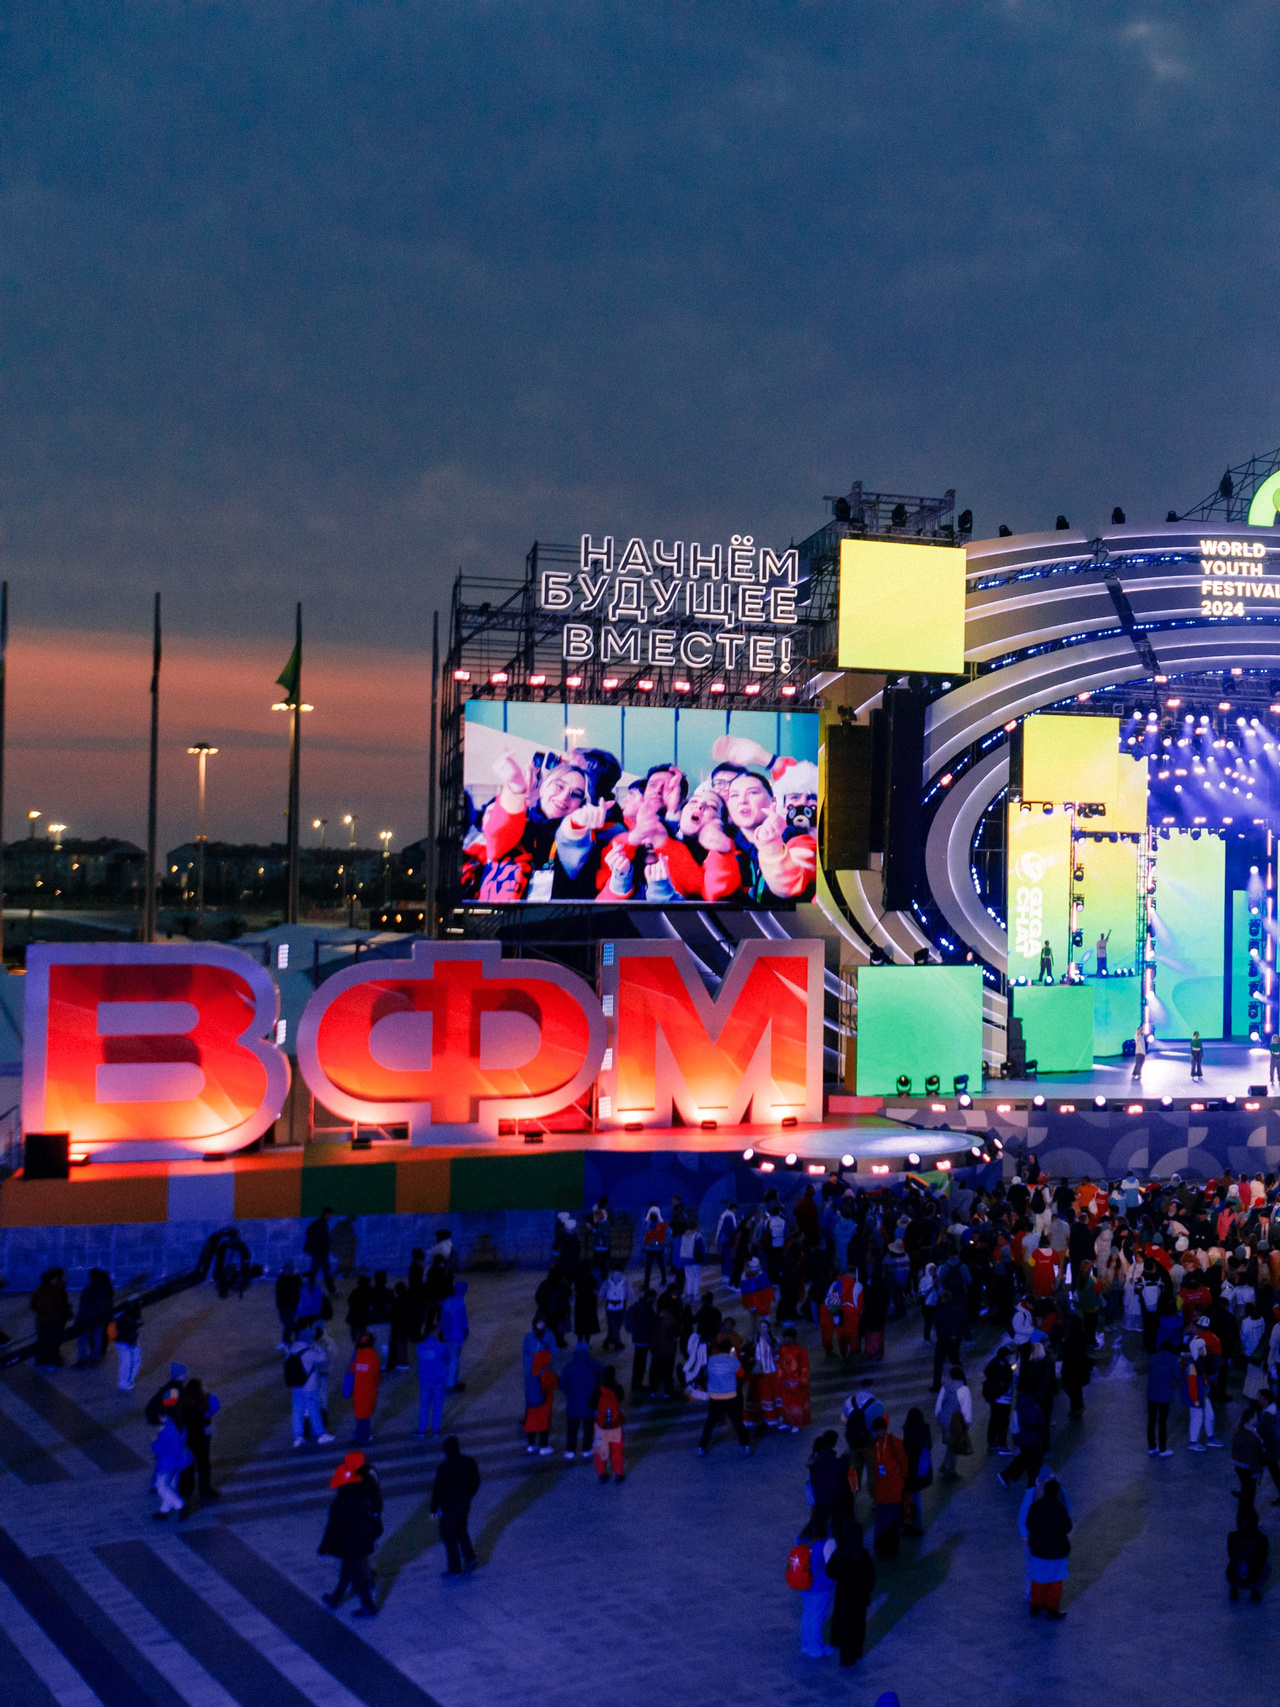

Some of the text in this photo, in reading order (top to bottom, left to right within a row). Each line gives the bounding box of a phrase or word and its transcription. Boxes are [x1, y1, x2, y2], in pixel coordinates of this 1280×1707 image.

[581, 534, 798, 585] НАЧНЁМ
[1200, 540, 1266, 558] WORLD
[1200, 560, 1263, 577] YOUTH
[541, 571, 798, 628] БУДУЩЕЕ
[1201, 600, 1245, 617] 2024
[563, 624, 792, 674] ВМЕСТЕ!
[1016, 886, 1030, 957] CHAT
[1028, 887, 1042, 957] GIGA
[23, 939, 825, 1160] ВФМ
